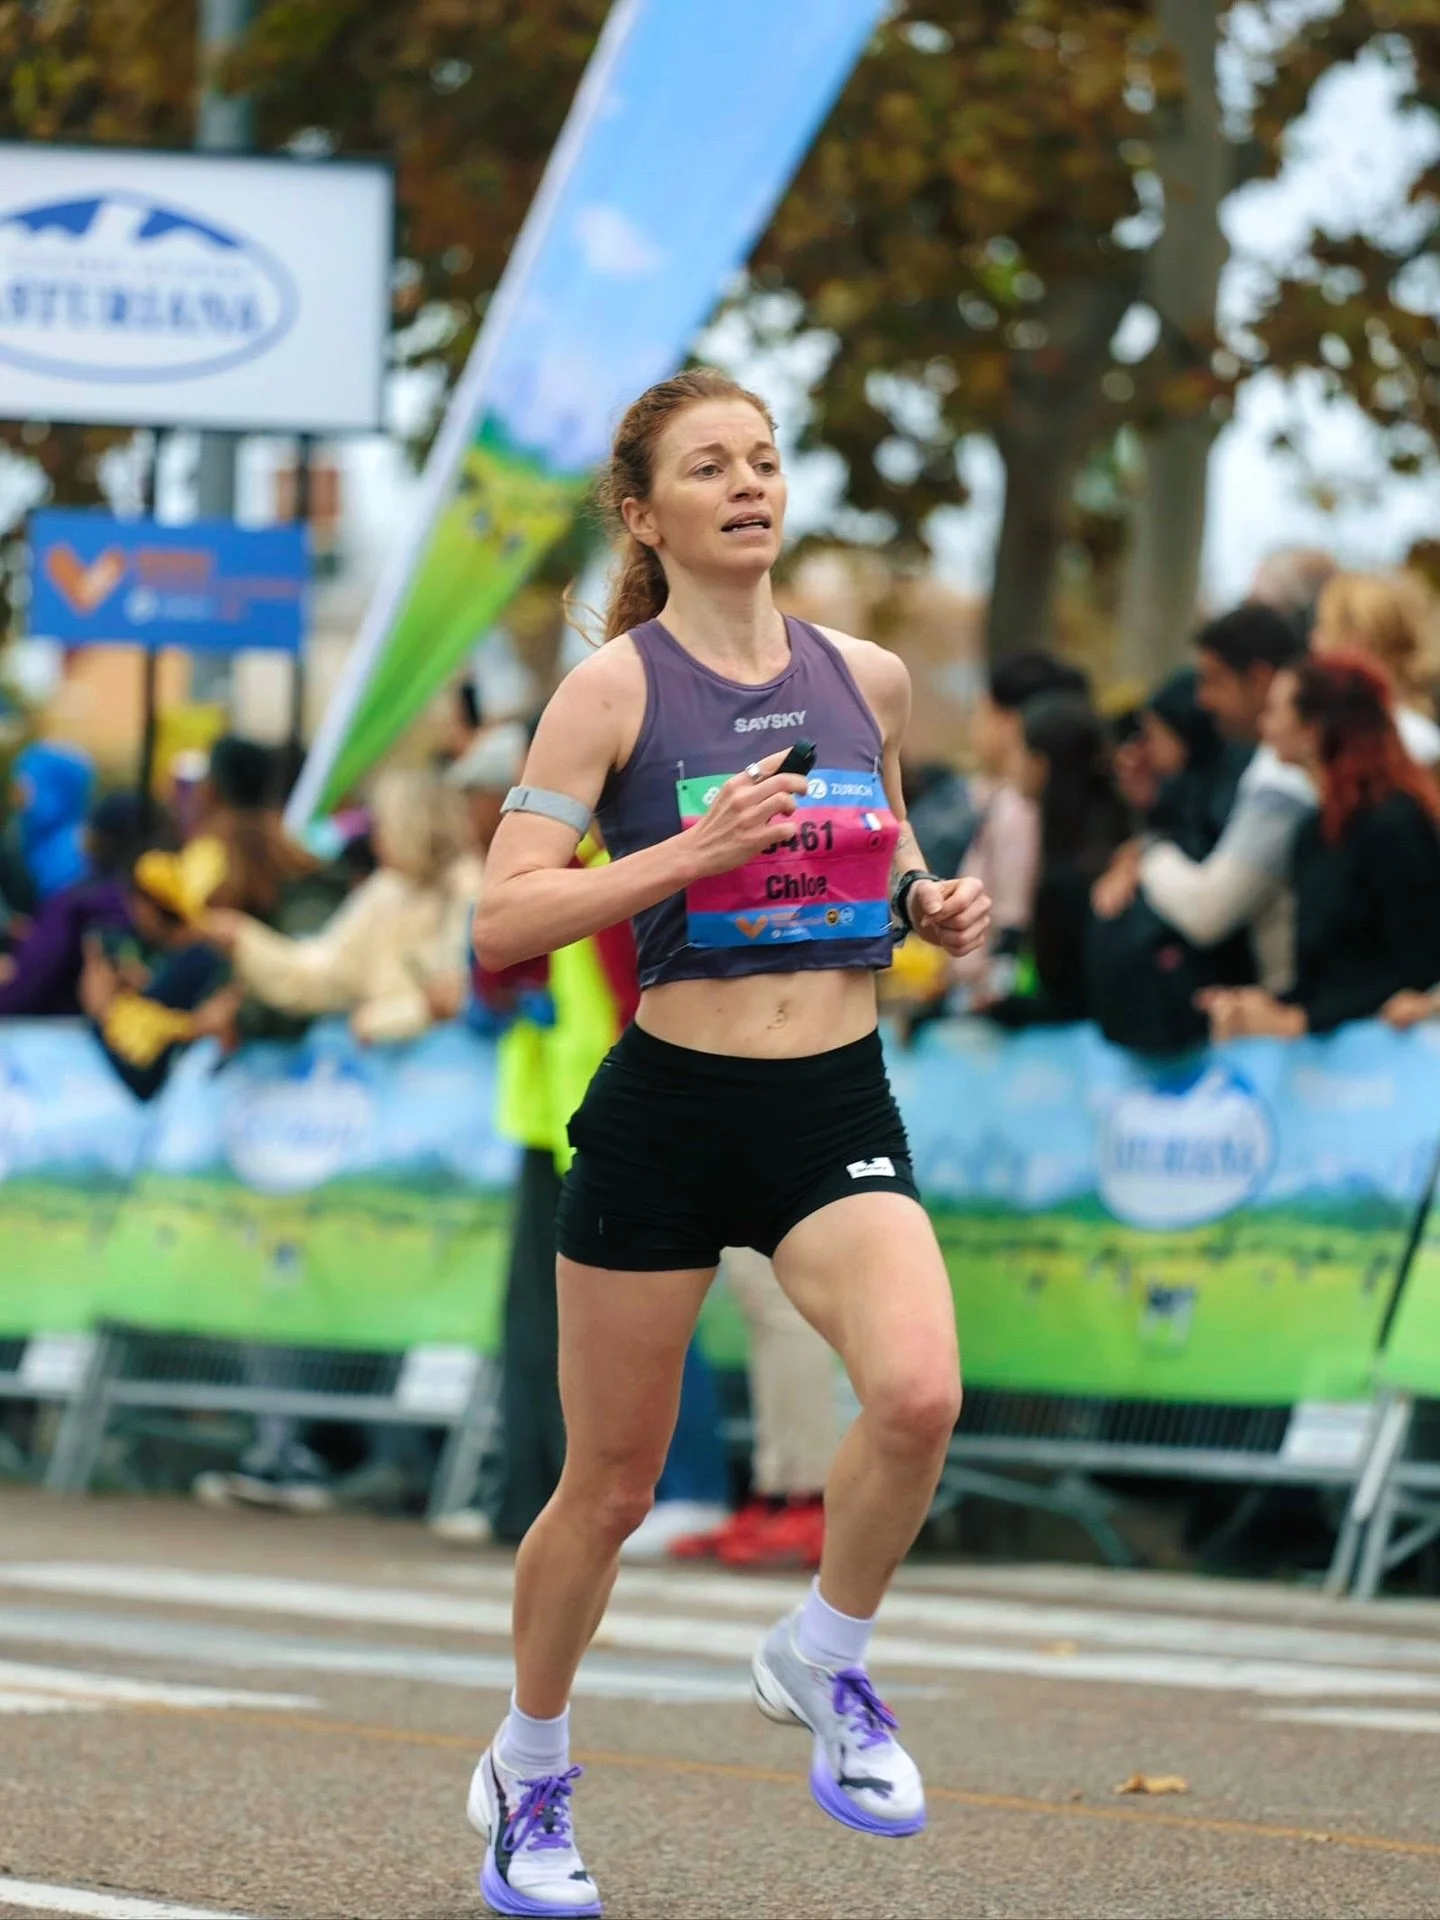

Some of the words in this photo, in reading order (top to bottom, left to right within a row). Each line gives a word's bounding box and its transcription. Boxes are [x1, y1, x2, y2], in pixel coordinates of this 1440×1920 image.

[734, 709, 807, 733] SAYSKY
[830, 782, 873, 797] ZURICH
[766, 872, 828, 900] Chloe
